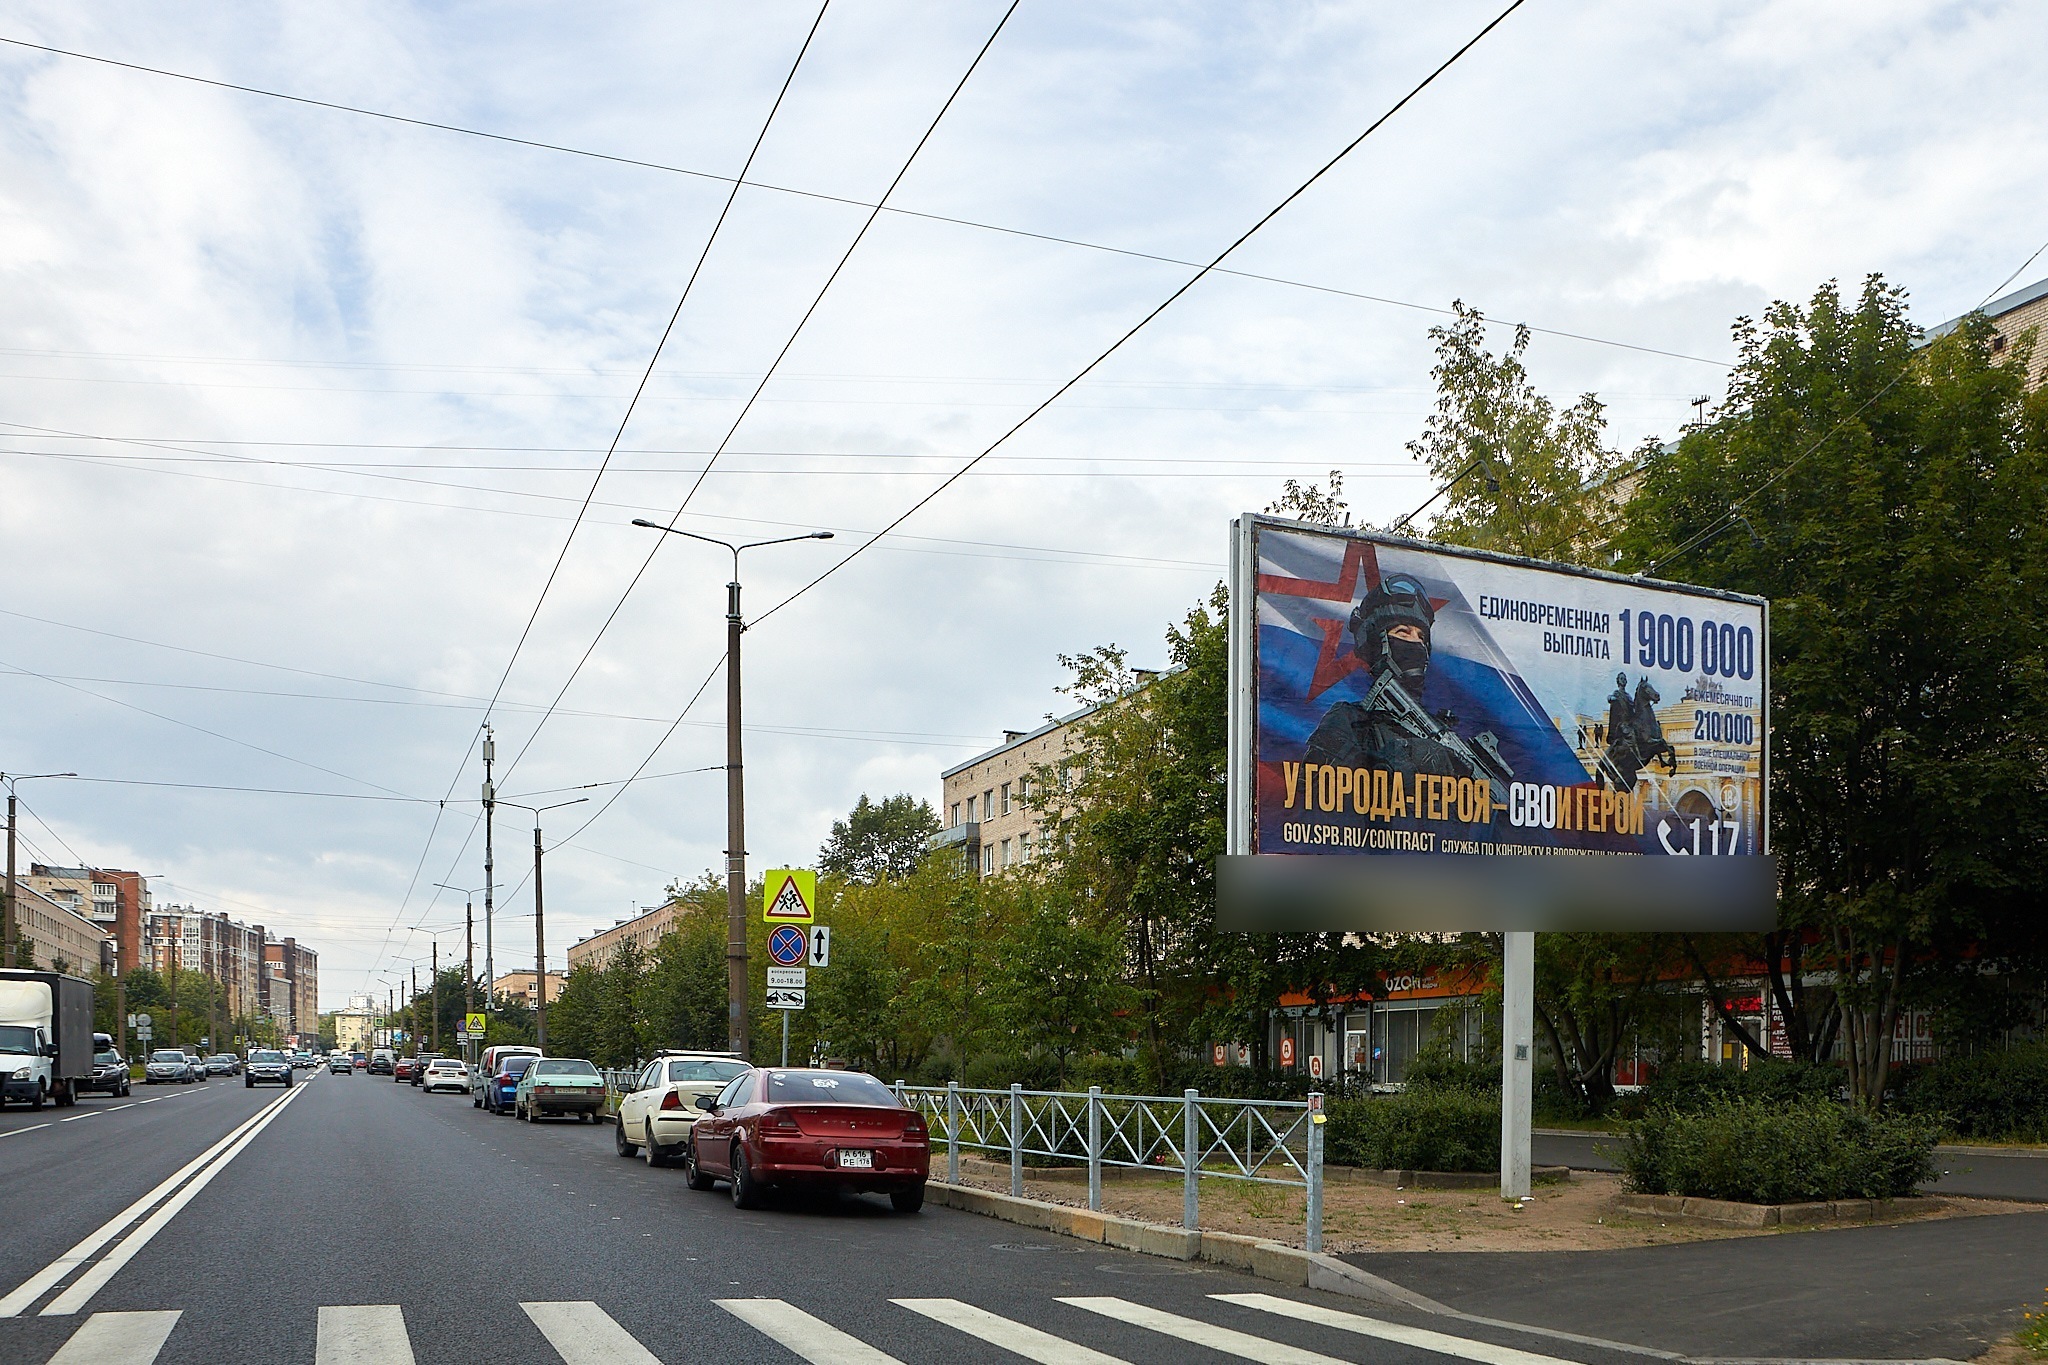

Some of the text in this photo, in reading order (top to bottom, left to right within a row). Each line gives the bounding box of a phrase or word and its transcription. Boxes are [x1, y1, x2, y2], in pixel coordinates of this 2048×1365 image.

[1479, 595, 1610, 634] ЕДИНОВРЕМЕННАЯ
[1543, 631, 1611, 661] ВЫПЛАТА
[1619, 608, 1754, 681] 1 900 000
[1694, 689, 1753, 708] ЕЖЕМЕСЯЧНО ОТ
[1694, 709, 1753, 746] 210 000
[1282, 761, 1300, 809] У
[1304, 763, 1490, 824] ГОРОДА-ГЕРОЯ
[1509, 781, 1571, 831] СВОИ
[1576, 787, 1644, 836] ГЕРОИ
[1283, 822, 1436, 852] GOV.SPB.RU/CONTRACT
[1441, 839, 1479, 855] СЛУЖБА
[1481, 842, 1494, 855] ПО
[1496, 843, 1545, 855] КОНТРАКТУ
[771, 977, 803, 985] 9.00-18.00
[843, 1158, 855, 1166] РЕ
[852, 1149, 867, 1158] 616
